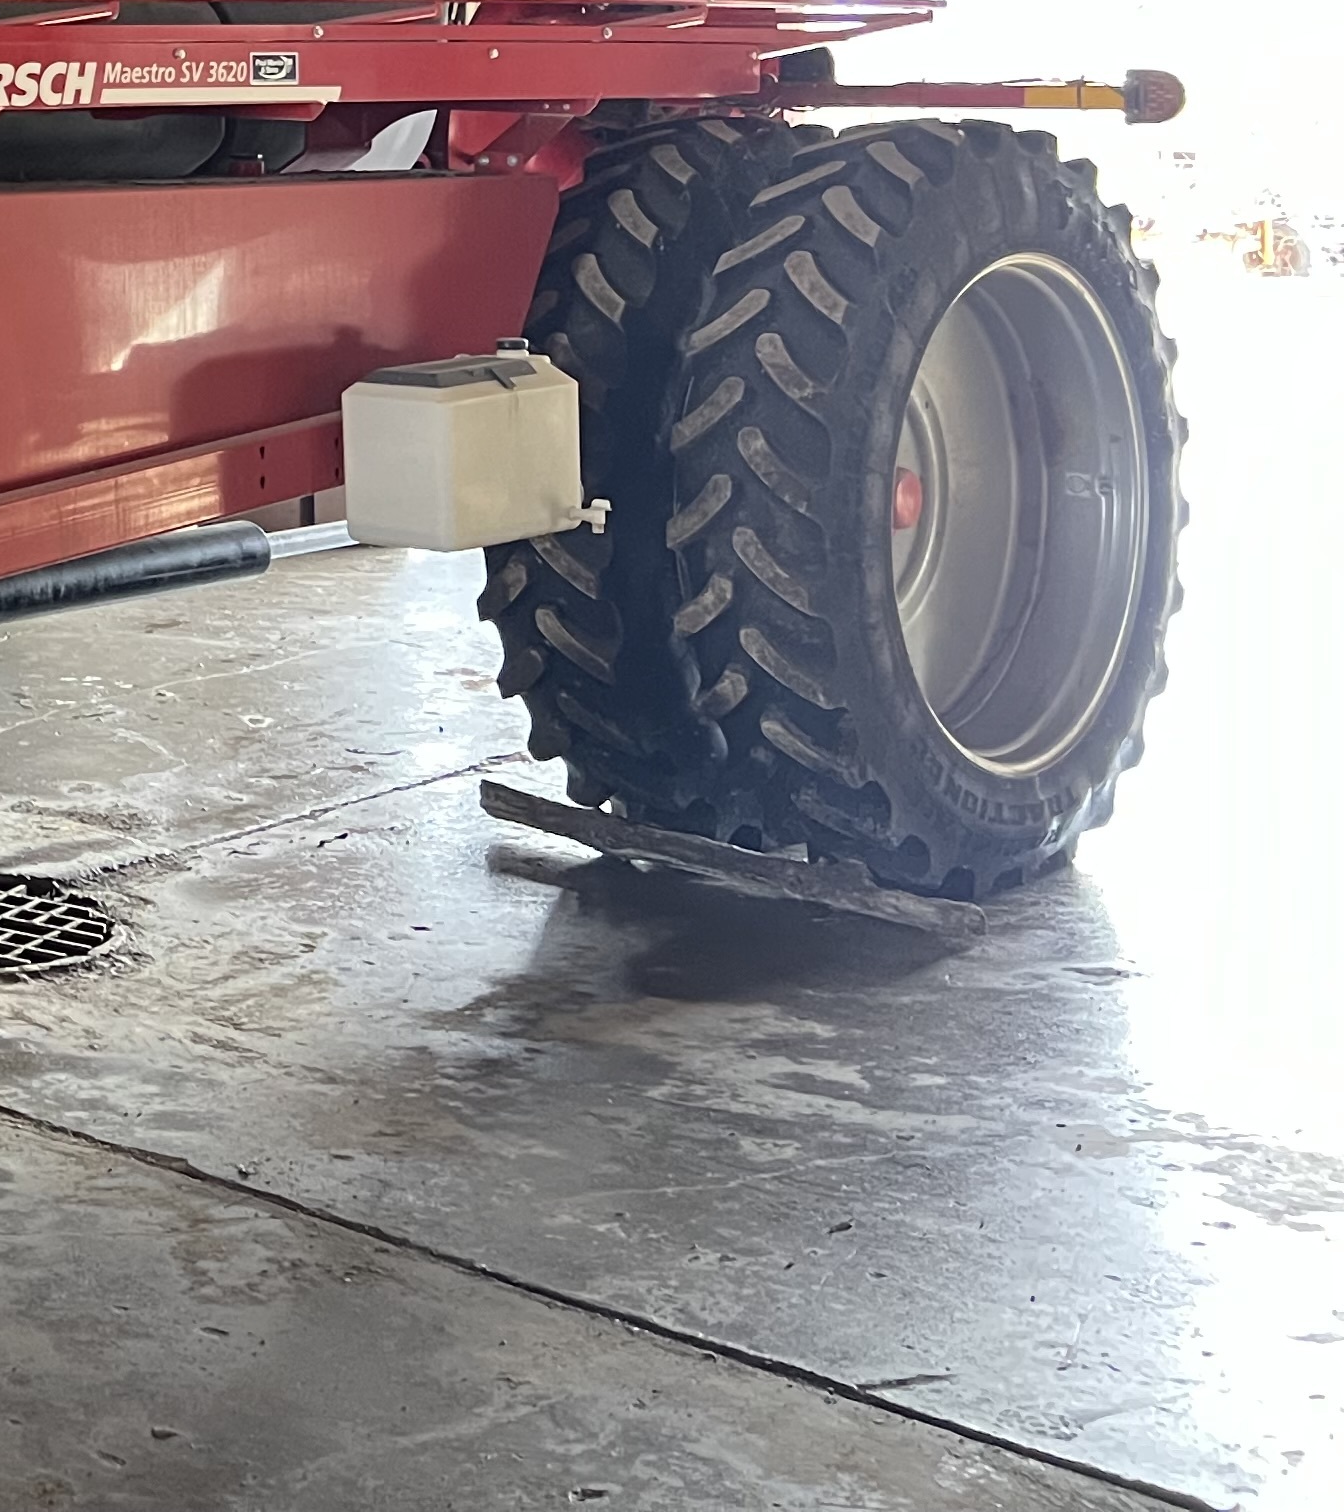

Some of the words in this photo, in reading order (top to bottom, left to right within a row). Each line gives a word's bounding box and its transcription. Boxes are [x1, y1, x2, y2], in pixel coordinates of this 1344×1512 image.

[102, 61, 176, 84] Maestro
[179, 61, 205, 83] SV
[206, 61, 248, 83] 3620
